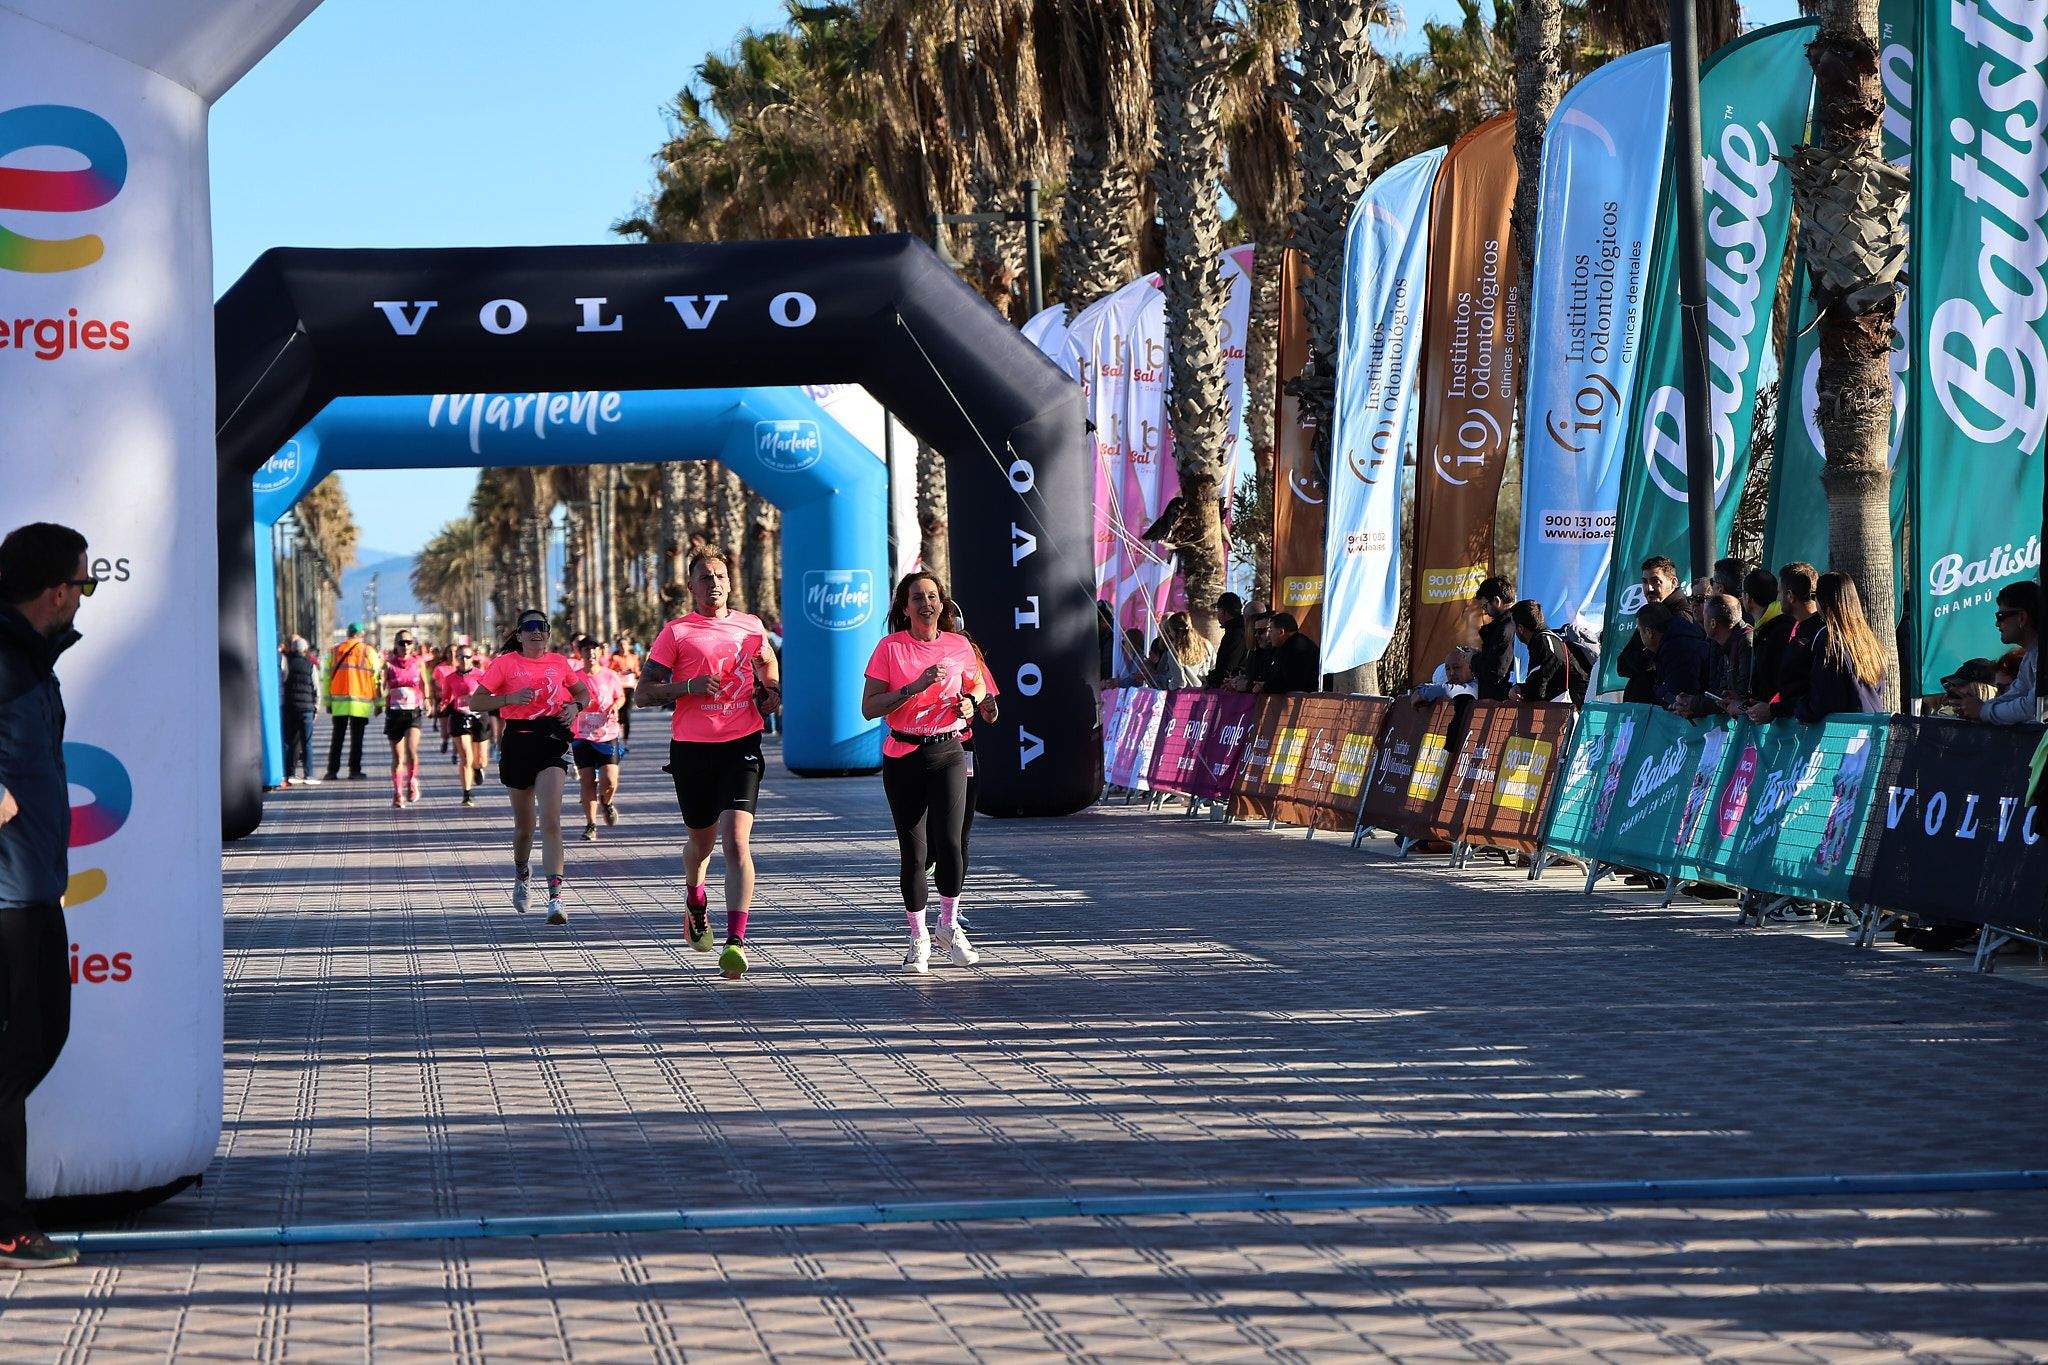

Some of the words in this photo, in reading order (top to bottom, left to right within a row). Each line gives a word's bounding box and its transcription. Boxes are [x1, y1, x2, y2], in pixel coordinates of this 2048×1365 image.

[1929, 0, 2048, 456] Batist
[1590, 200, 1621, 365] Odontológicos
[1626, 240, 1642, 304] dentales
[373, 291, 817, 336] VOLVO
[1472, 240, 1499, 400] Odontológicos
[1504, 286, 1518, 343] dentales
[1565, 254, 1590, 363] Institutos
[1622, 307, 1637, 364] Clínicas
[1365, 321, 1384, 412] Institutos
[1383, 278, 1408, 412] Odontológicos
[1448, 292, 1471, 399] Institutos
[1501, 347, 1513, 399] Clínicas
[428, 391, 622, 454] Marlene
[760, 431, 817, 458] Marlene
[1545, 516, 1572, 527] 900
[1574, 516, 1592, 527] 131
[1595, 516, 1617, 527] 002
[808, 584, 869, 614] Marlene
[1008, 459, 1044, 770] VOLVO
[1934, 588, 1992, 618] CHAMPÚ
[1219, 713, 1245, 757] renfe
[1628, 736, 1688, 807] Batiste
